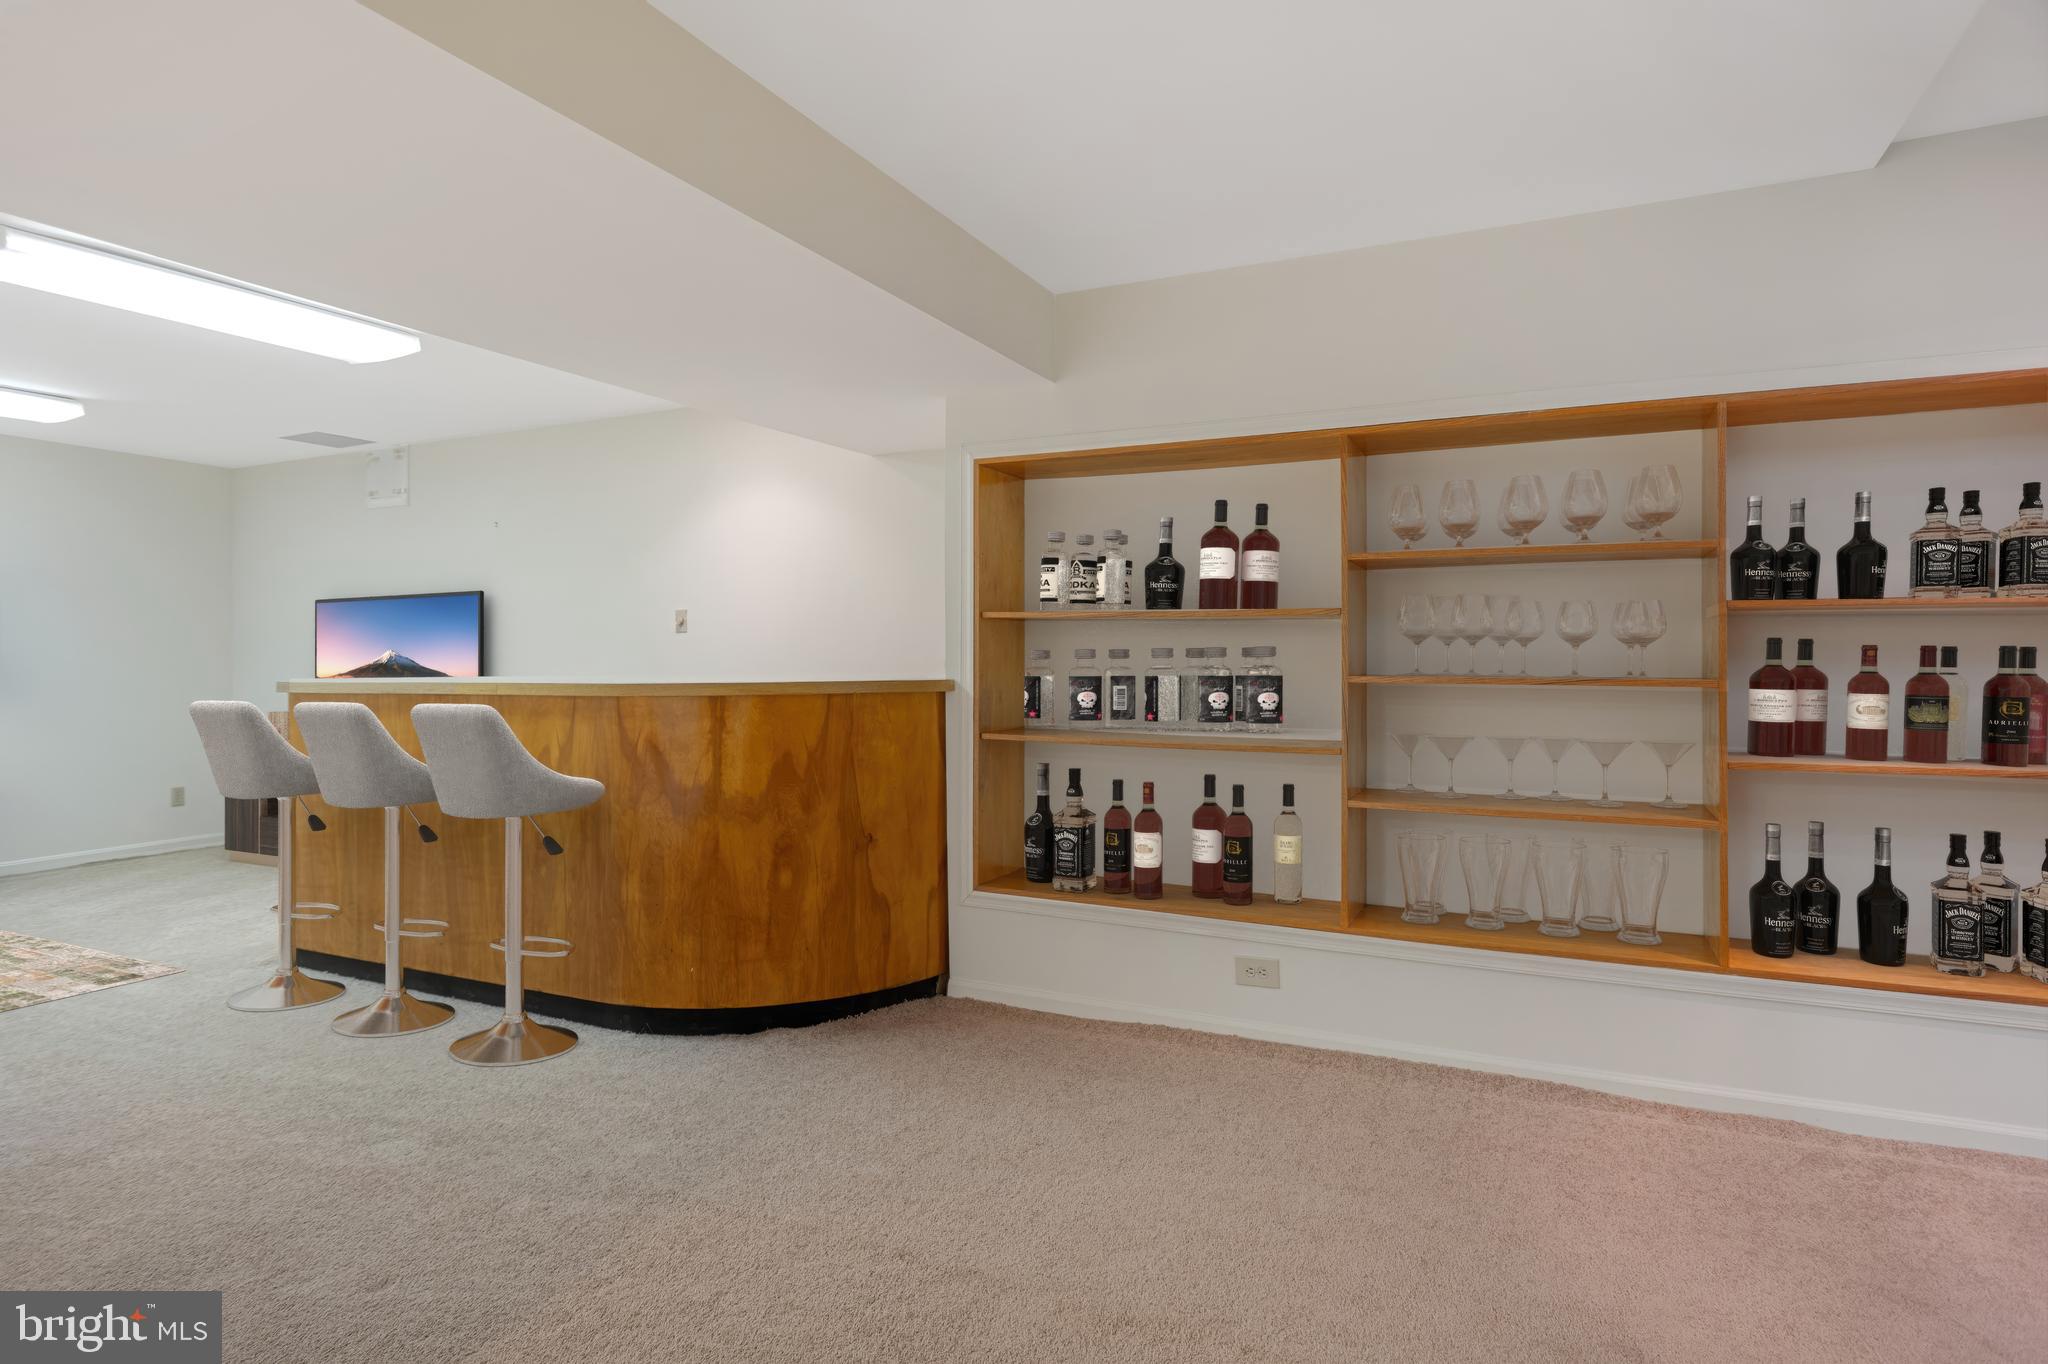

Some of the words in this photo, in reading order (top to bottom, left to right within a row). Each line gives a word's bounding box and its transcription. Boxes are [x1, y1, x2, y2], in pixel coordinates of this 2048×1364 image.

[1923, 544, 1937, 553] JACK
[1945, 909, 1959, 918] JACK
[1959, 907, 1981, 921] DANIEL'S
[1764, 917, 1795, 928] Henness
